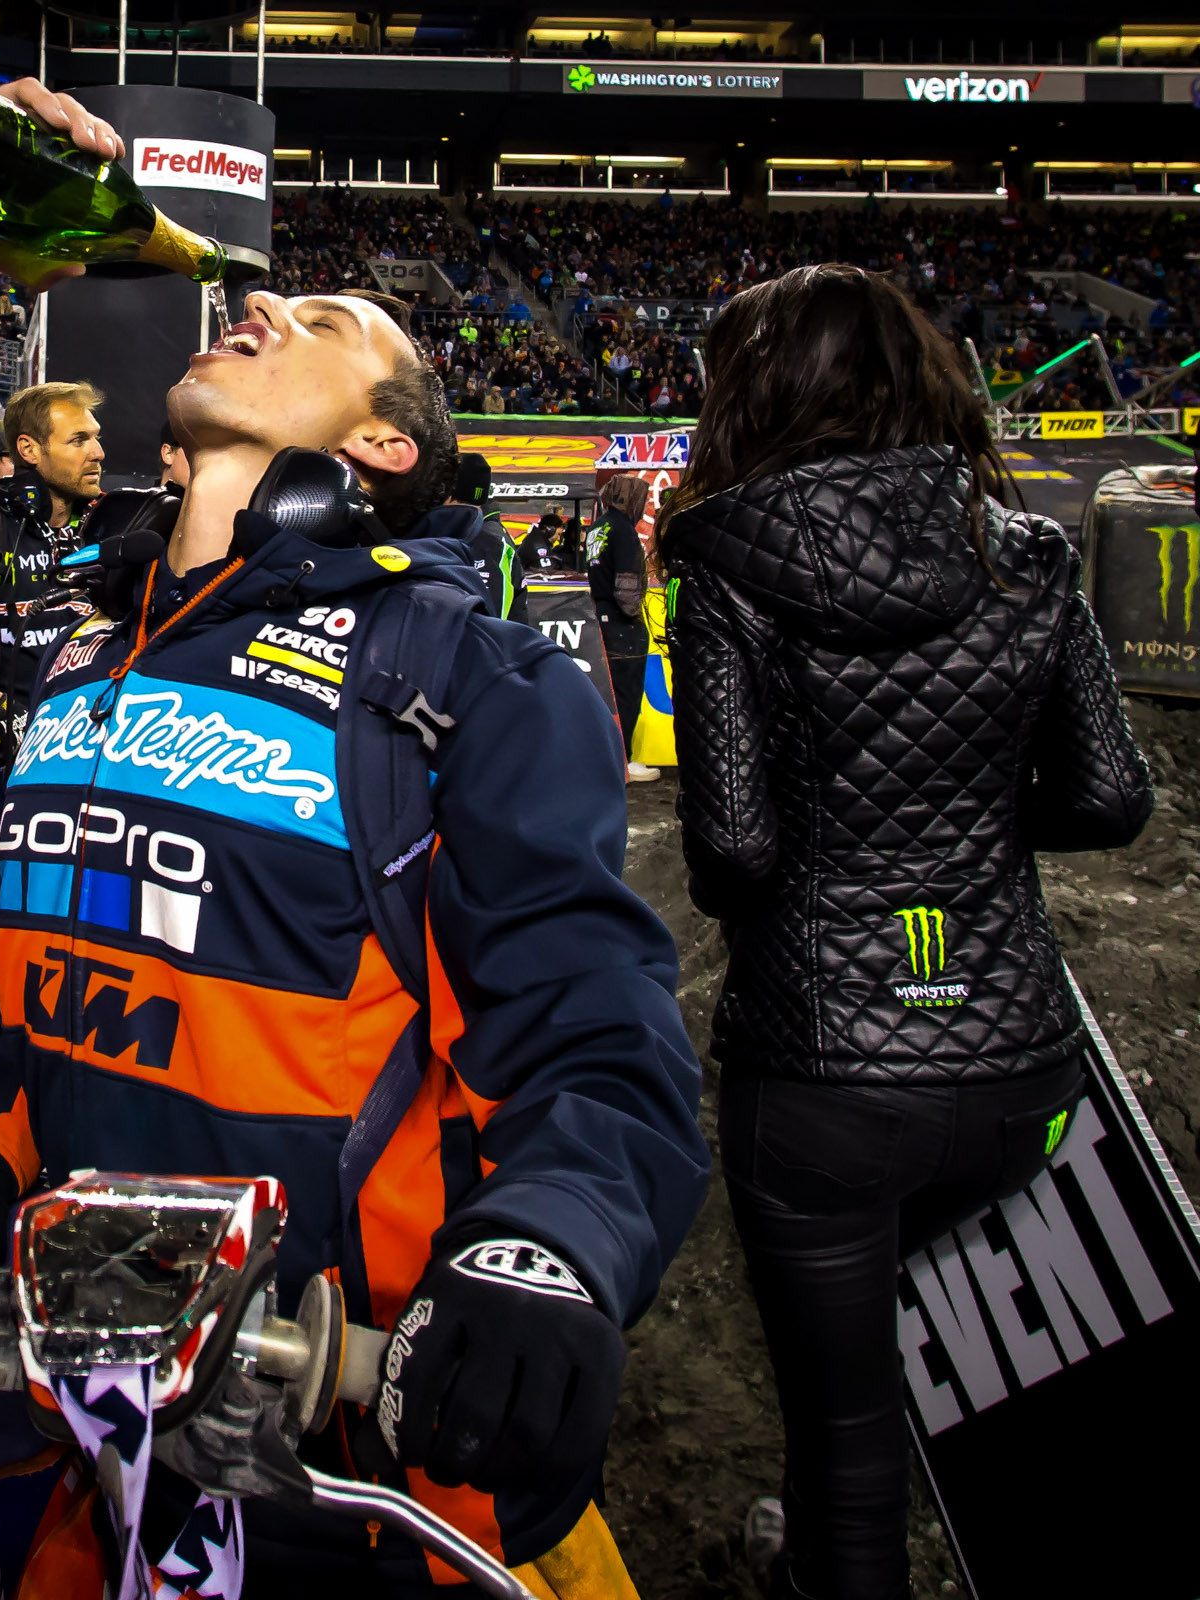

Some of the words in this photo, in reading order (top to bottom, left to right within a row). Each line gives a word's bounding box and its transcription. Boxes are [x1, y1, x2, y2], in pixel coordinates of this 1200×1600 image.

[597, 73, 712, 88] WASHINGTON'S
[717, 75, 780, 90] LOTTERY
[905, 72, 1029, 102] verizon
[141, 147, 204, 174] Fred
[204, 151, 263, 185] Meyer
[374, 264, 425, 281] 204
[1047, 418, 1098, 432] THOR
[599, 434, 690, 463] AMA
[256, 623, 349, 669] KÄRC
[1124, 640, 1200, 662] MONS
[266, 668, 341, 711] seas
[104, 692, 335, 803] Designs
[895, 984, 969, 999] MONSTER
[904, 999, 963, 1008] ENERGY
[24, 946, 180, 1071] KTM
[898, 1097, 1174, 1437] EVENT
